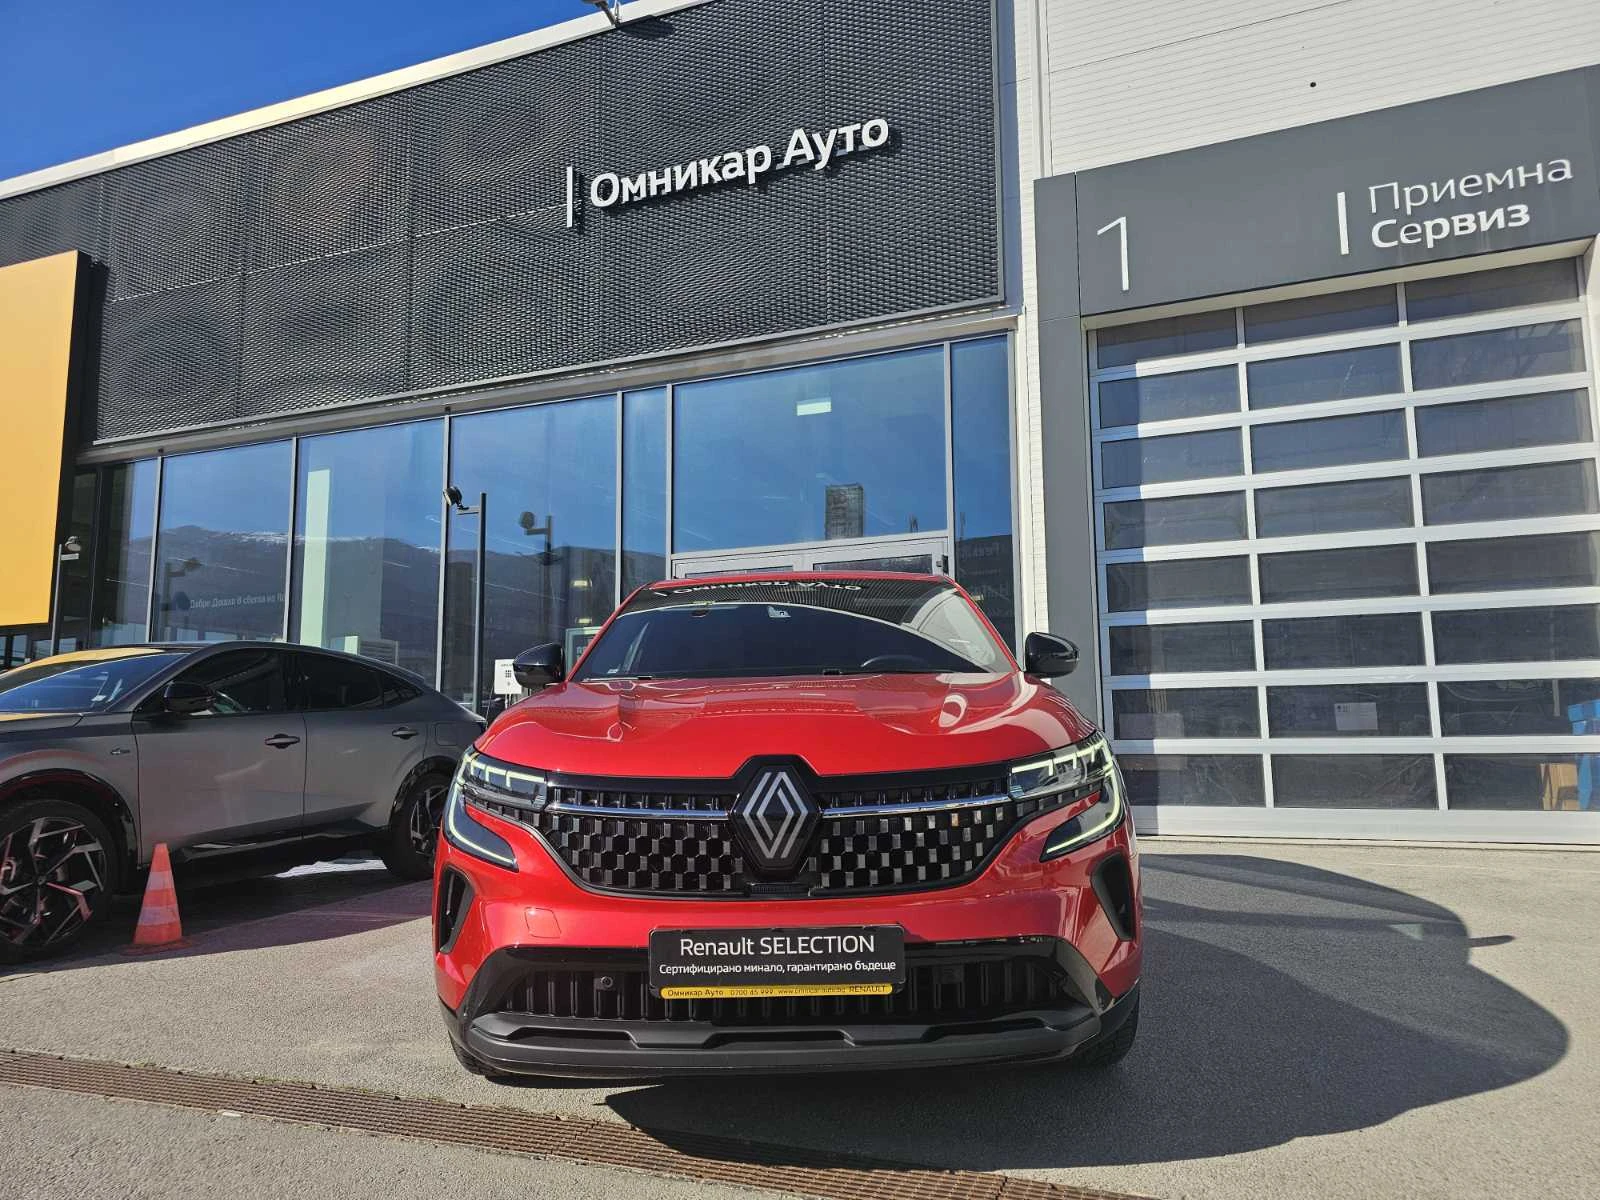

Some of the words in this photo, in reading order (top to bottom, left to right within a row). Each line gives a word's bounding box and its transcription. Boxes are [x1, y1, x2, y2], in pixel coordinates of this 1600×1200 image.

[590, 144, 772, 208] Омникар
[783, 118, 889, 171] Ауто
[1368, 158, 1574, 216] Приемна
[1371, 203, 1531, 249] Сервиз
[1096, 216, 1129, 291] 1
[659, 963, 742, 975] Сертифицирано
[743, 963, 785, 973] минало,
[787, 962, 852, 973] гарантирано
[854, 960, 897, 971] бъдеще
[680, 937, 755, 956] Renault
[760, 935, 875, 955] SELECTION
[667, 989, 703, 998] Омникар
[705, 989, 724, 997] Ауто
[849, 985, 886, 993] RENAULT
